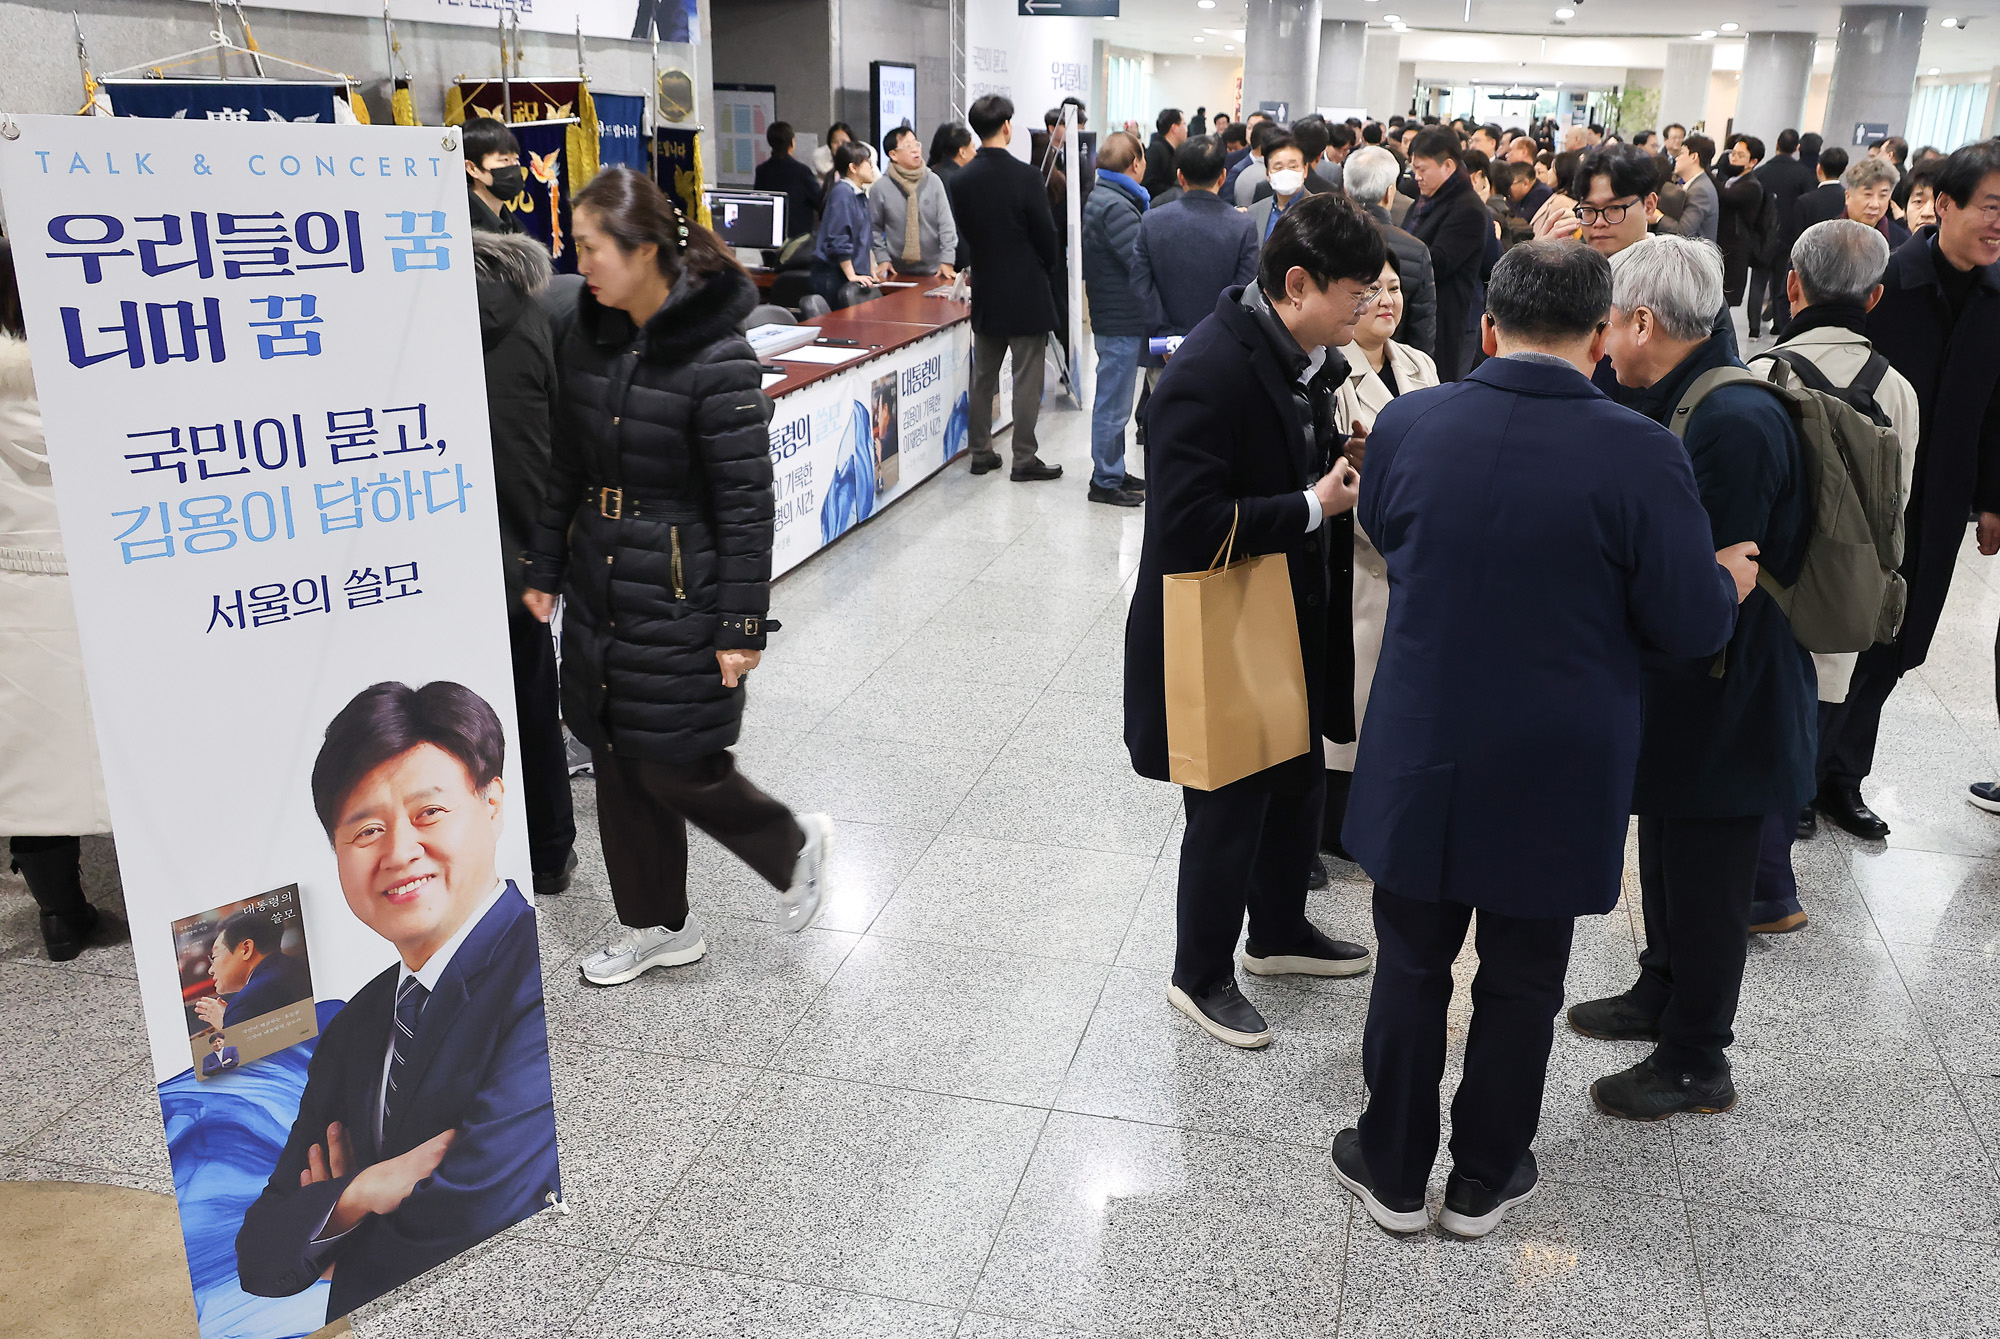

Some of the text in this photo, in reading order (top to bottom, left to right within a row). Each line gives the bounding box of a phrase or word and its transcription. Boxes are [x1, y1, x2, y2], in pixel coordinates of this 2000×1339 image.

[35, 151, 441, 177] TALK & CONCERT
[46, 210, 453, 284] 우리들의 꿈
[59, 294, 324, 369] 너머 꿈
[901, 354, 940, 397] 대통령의
[768, 401, 842, 466] 통령의 쓸모
[903, 393, 941, 430] 김용이 기록한
[124, 403, 447, 484] 국민이 묻고,
[903, 415, 941, 454] 이재명의 시간
[784, 461, 813, 497] 기록한
[111, 463, 473, 565] 김용이 답하다
[772, 500, 793, 533] 명의
[796, 488, 814, 519] 시간
[206, 561, 423, 634] 서울의 쓸모
[242, 891, 292, 914] 대통령의
[271, 908, 296, 924] 쓸모
